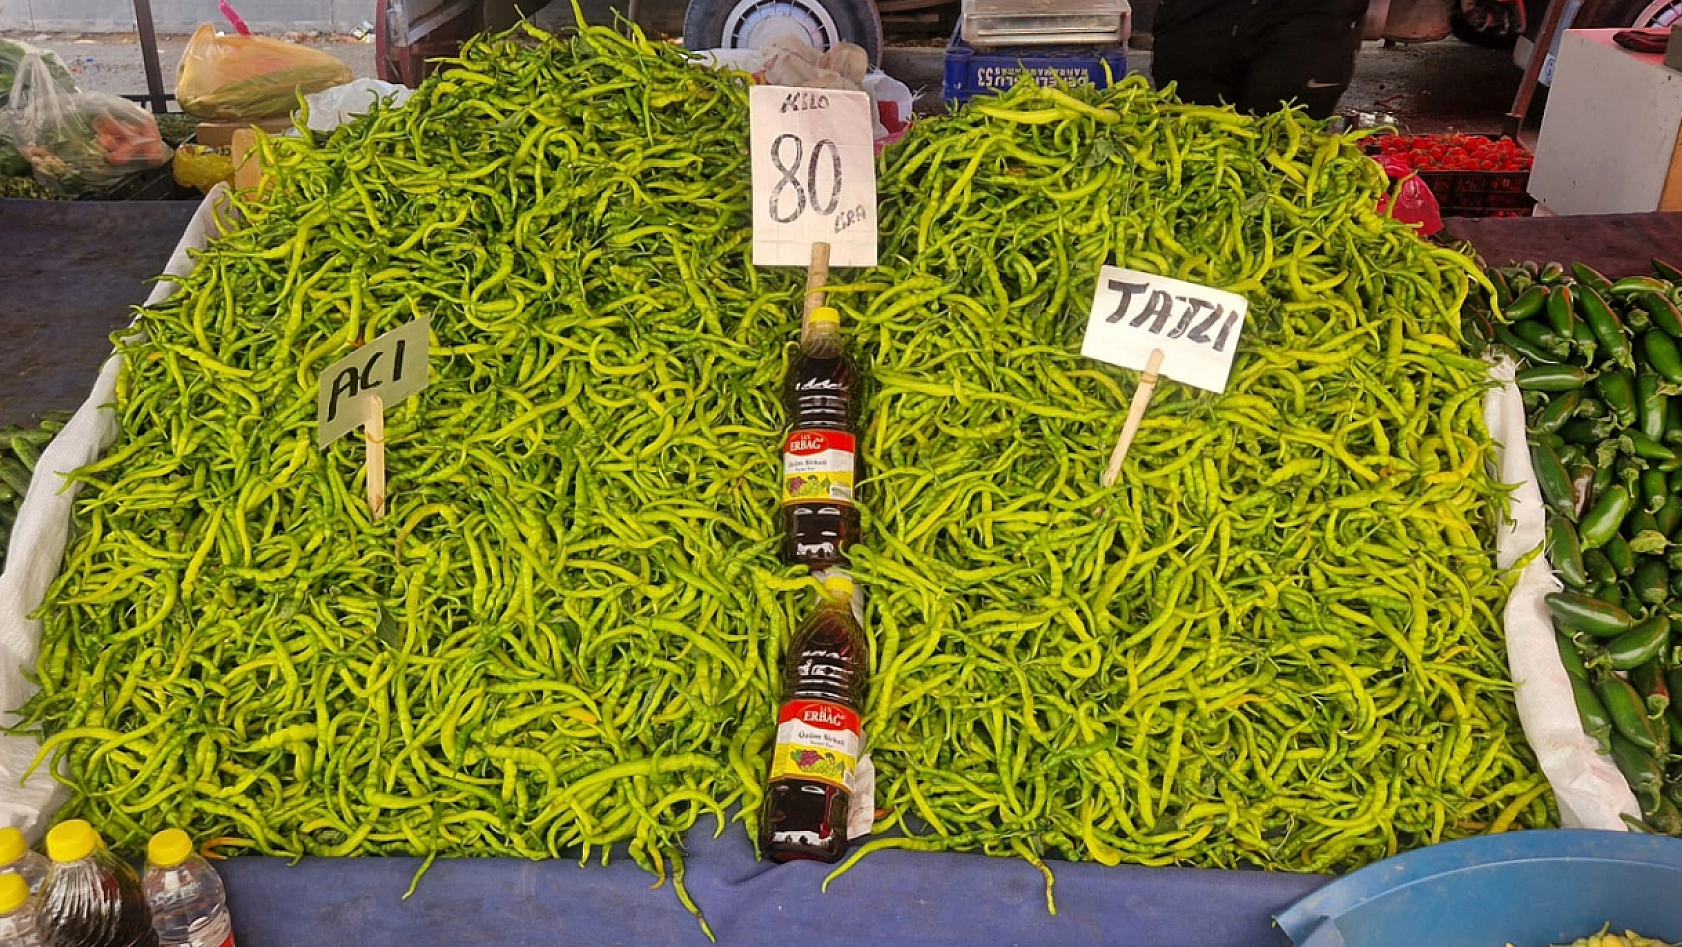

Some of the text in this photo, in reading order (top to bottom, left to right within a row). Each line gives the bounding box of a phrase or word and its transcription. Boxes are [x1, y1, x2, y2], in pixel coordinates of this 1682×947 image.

[768, 133, 843, 224] 80
[1105, 279, 1239, 352] TATLI
[327, 340, 405, 422] ACI
